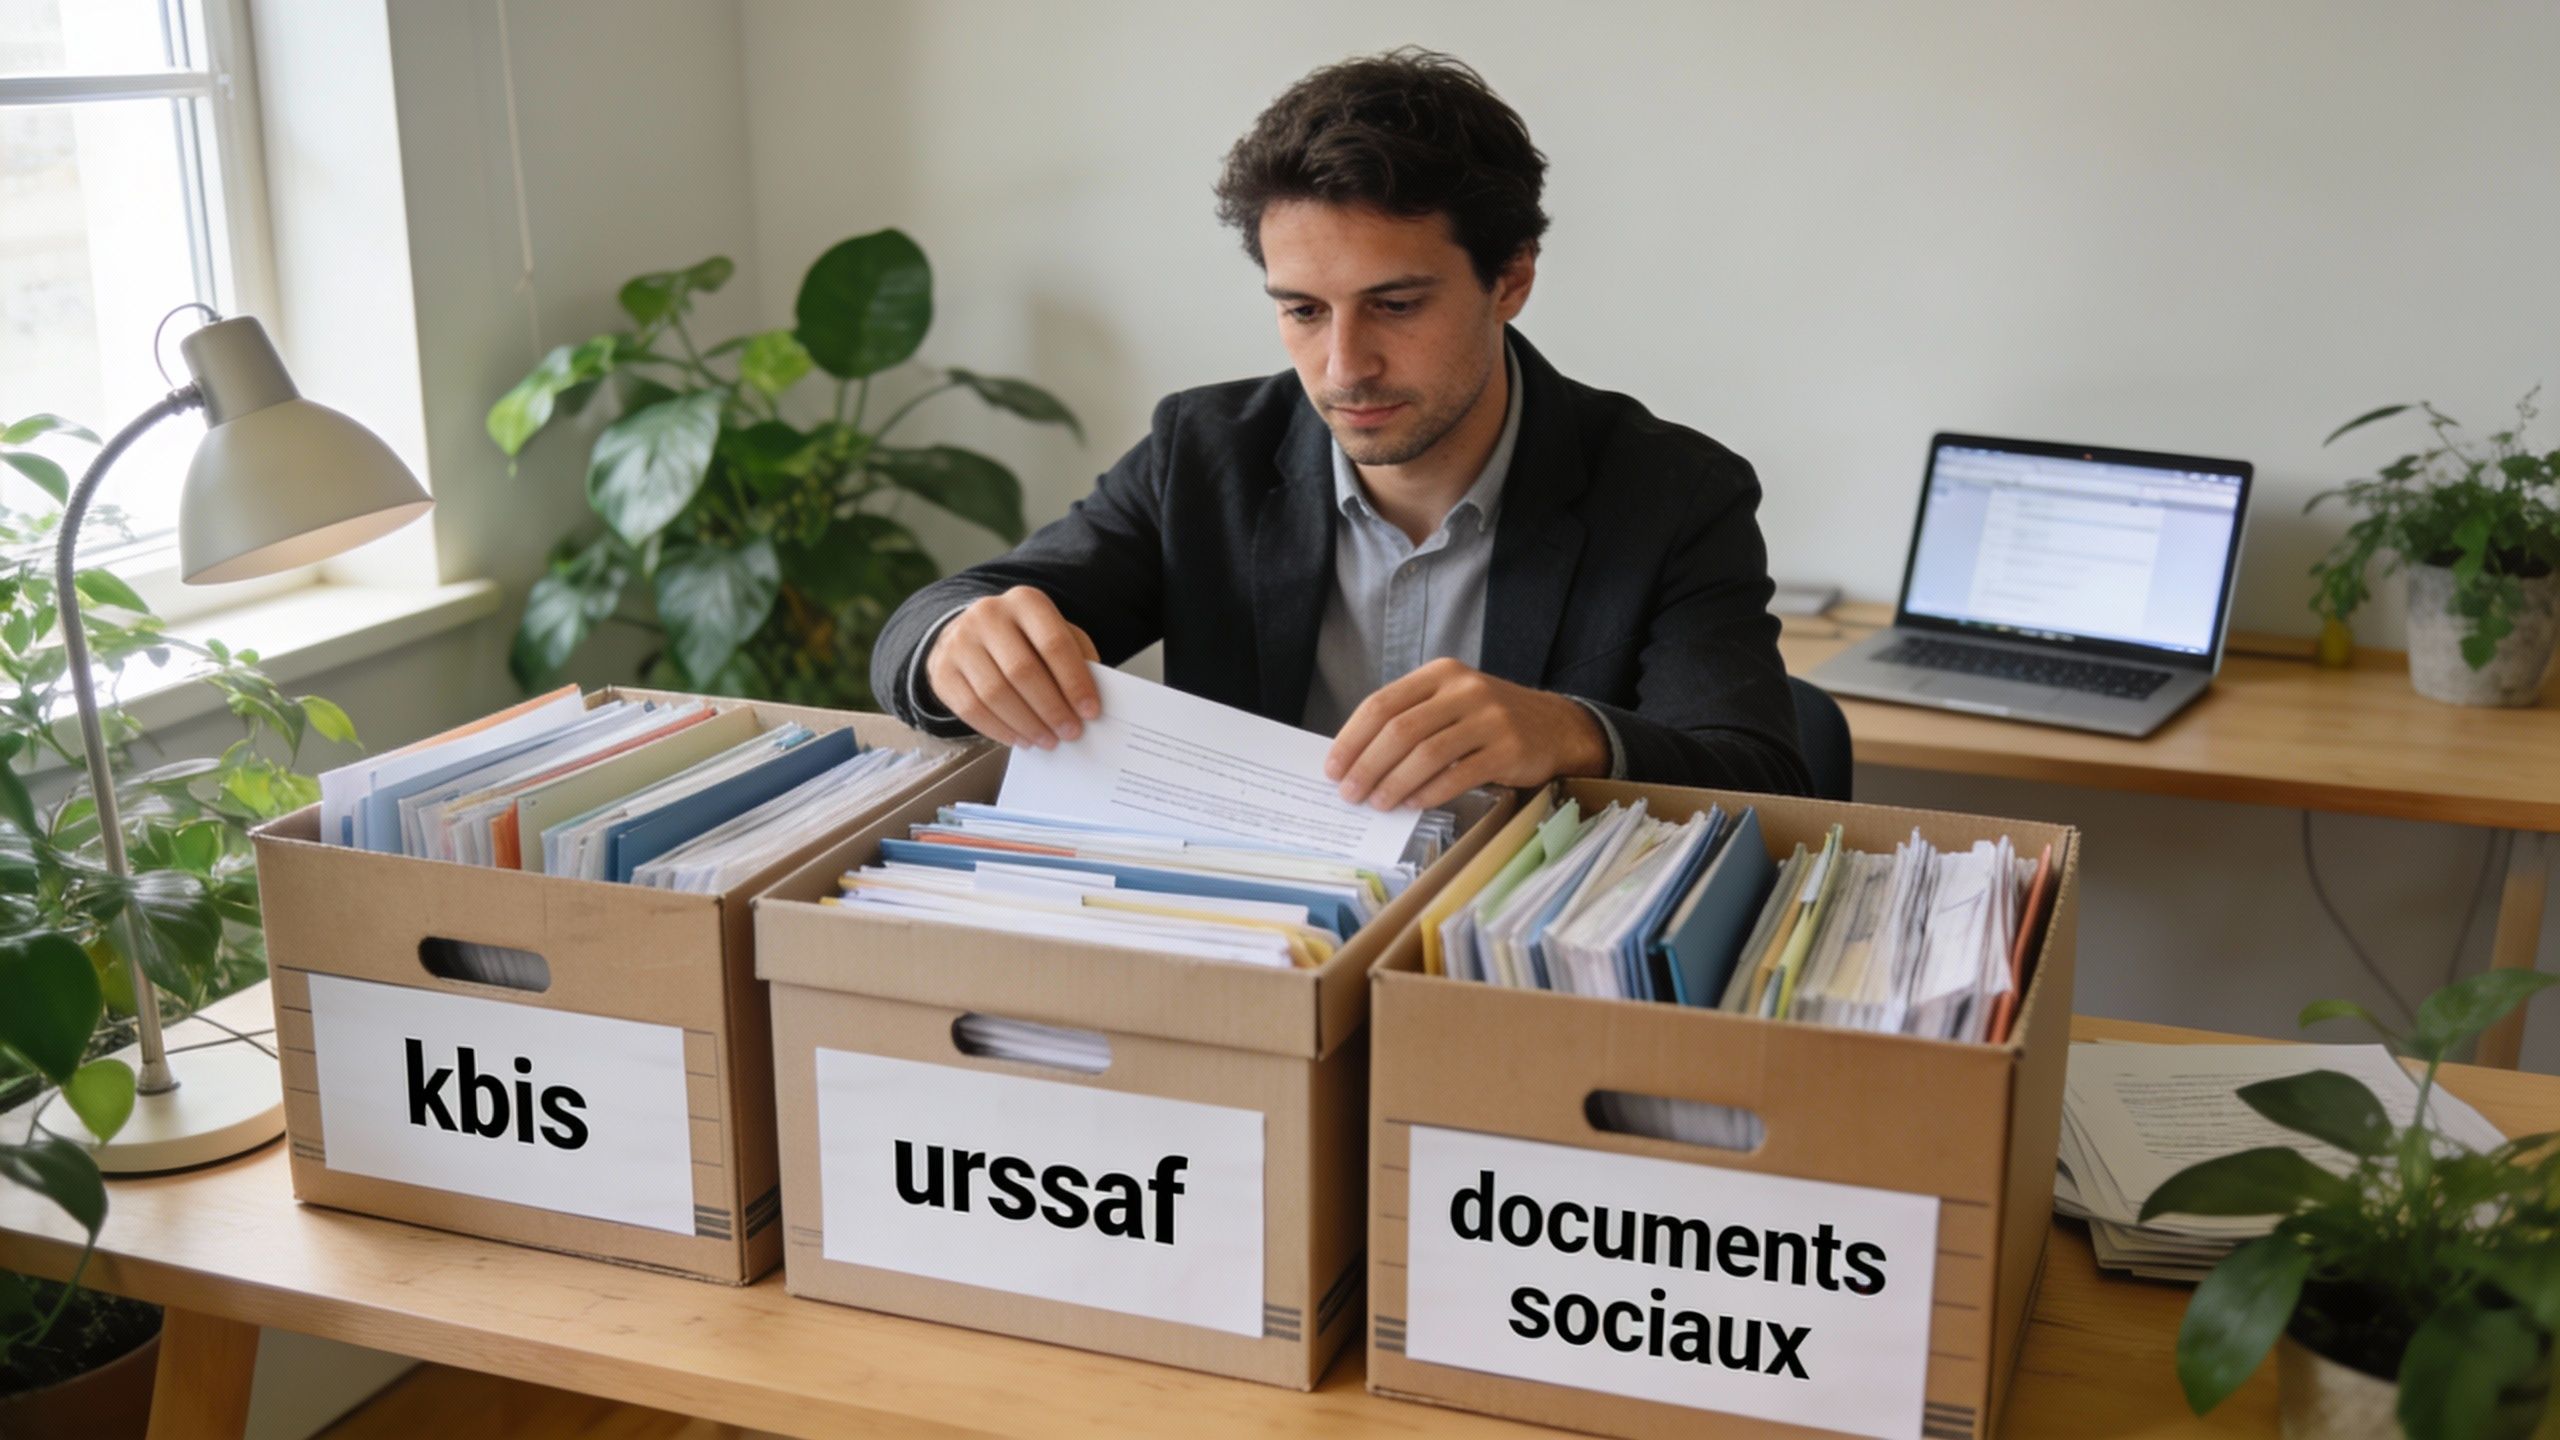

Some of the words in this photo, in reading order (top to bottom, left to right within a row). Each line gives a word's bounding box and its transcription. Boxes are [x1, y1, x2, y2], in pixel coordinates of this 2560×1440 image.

[405, 1037, 589, 1150] kbis
[894, 1139, 1189, 1245] urssaf
[1450, 1170, 1887, 1296] documents
[1508, 1287, 1812, 1380] sociaux
